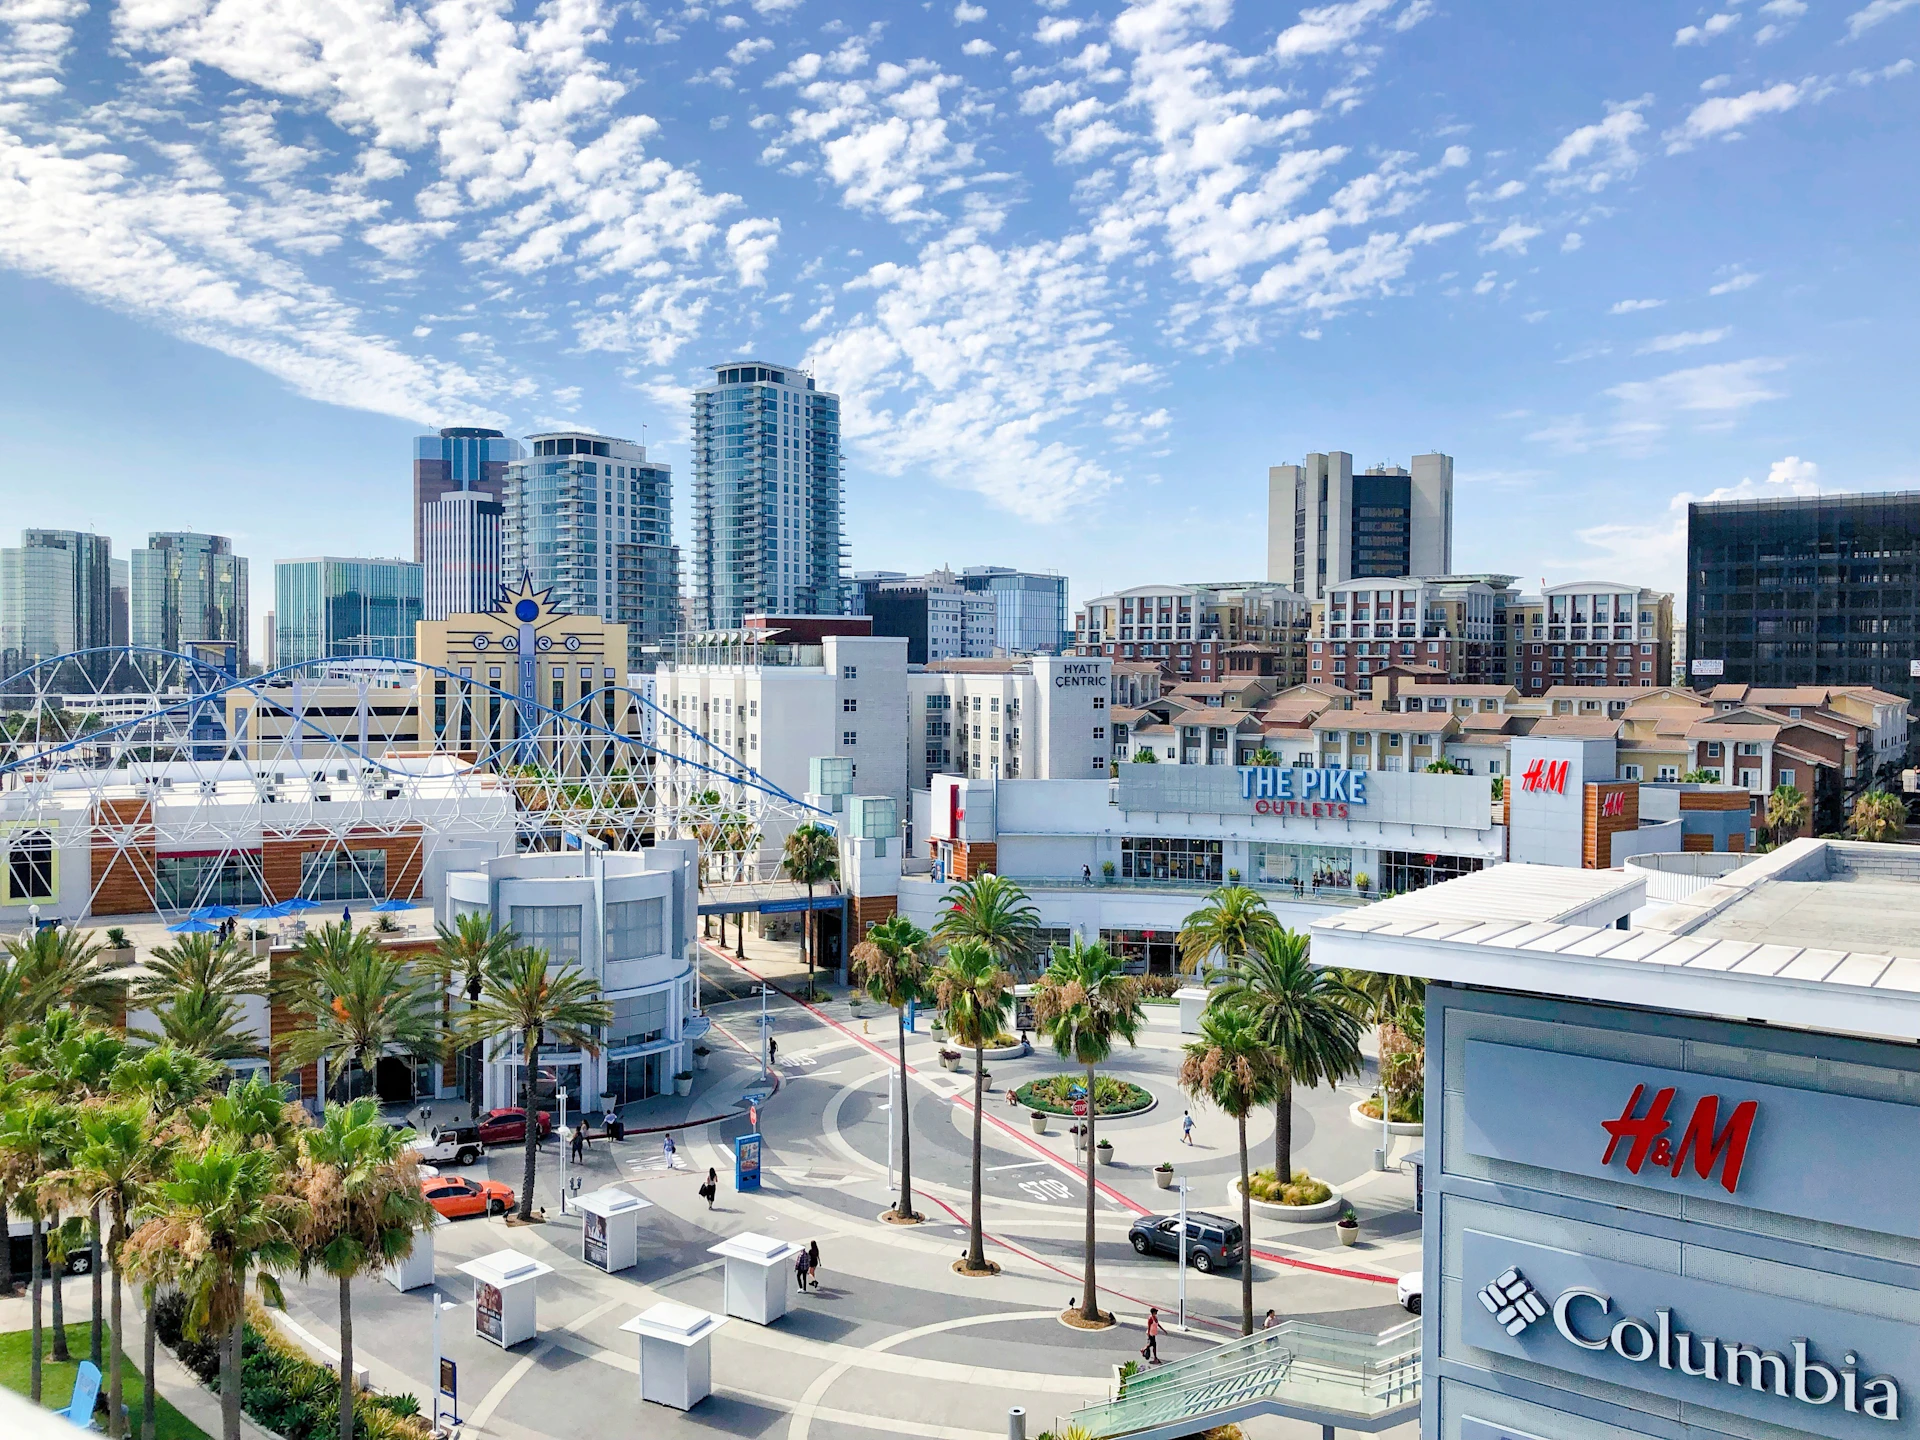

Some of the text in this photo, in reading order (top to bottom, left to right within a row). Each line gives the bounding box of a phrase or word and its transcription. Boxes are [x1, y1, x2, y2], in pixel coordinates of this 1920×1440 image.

[1064, 664, 1100, 674] HYATT
[1055, 676, 1107, 687] CENTRIC
[1238, 767, 1367, 804] THE PIKE
[1521, 758, 1570, 795] H&M
[1255, 799, 1349, 818] OUTLETS
[1073, 1104, 1087, 1113] STOP
[1601, 1082, 1759, 1194] H&M
[1018, 1178, 1075, 1202] STOP
[1552, 1285, 1901, 1421] Columbia
